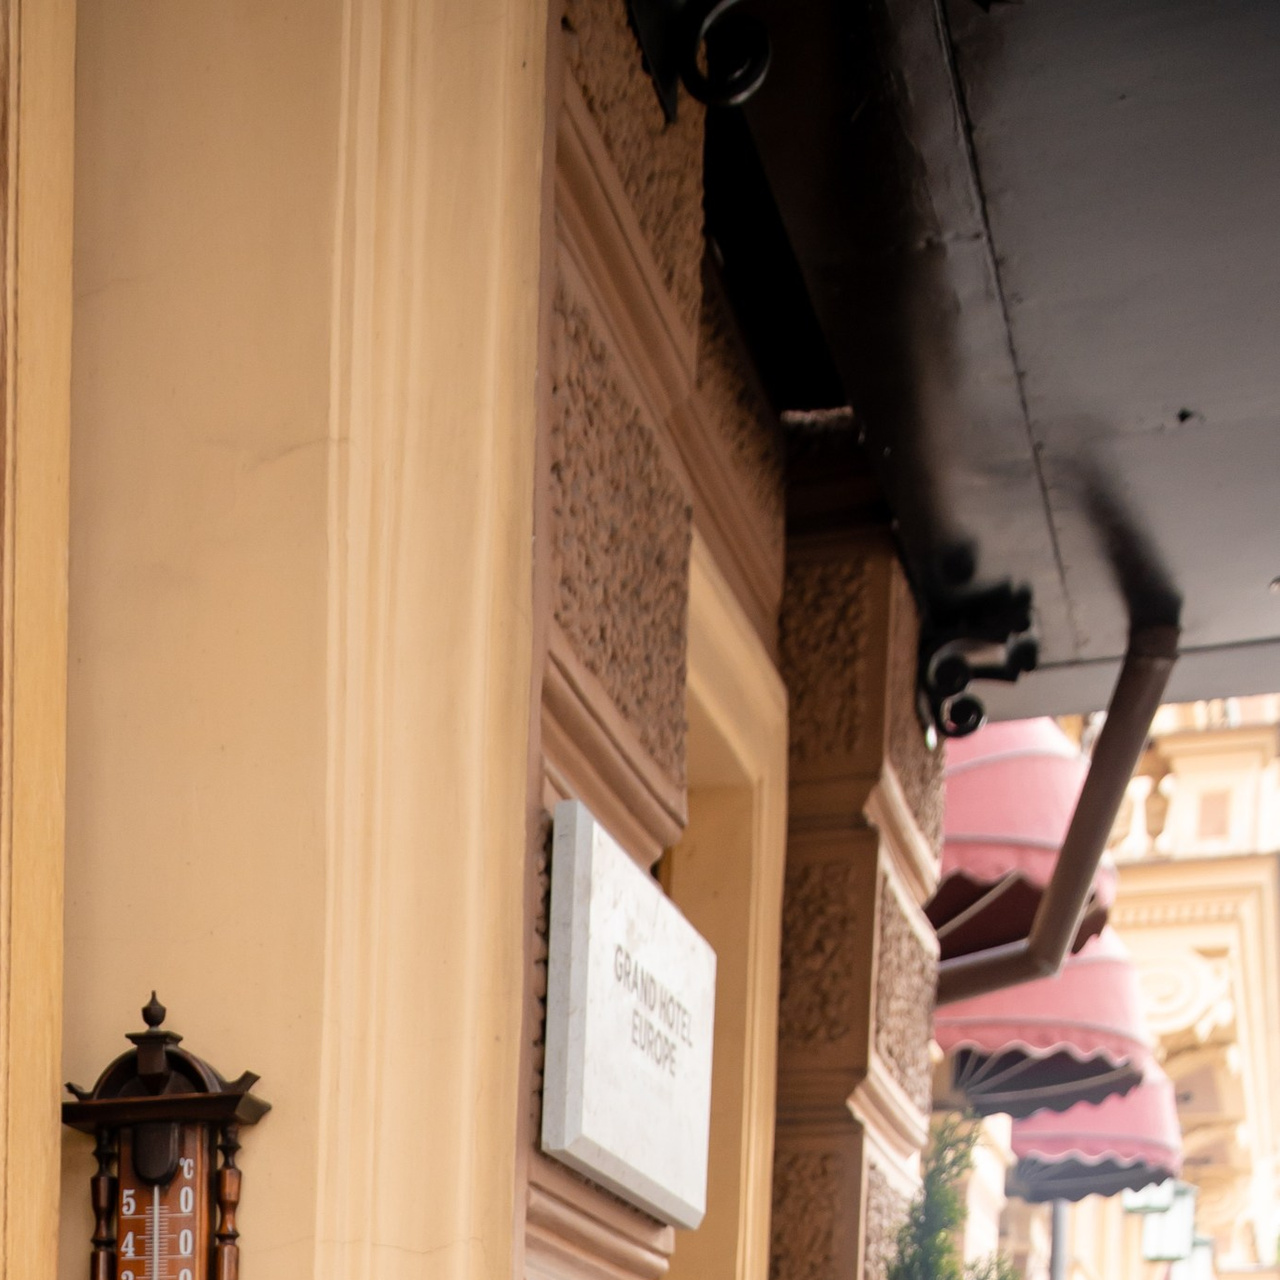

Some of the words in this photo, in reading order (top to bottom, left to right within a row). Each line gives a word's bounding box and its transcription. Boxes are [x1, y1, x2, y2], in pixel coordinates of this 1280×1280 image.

[614, 943, 657, 1012] GRAND
[658, 984, 694, 1049] HOTEL
[631, 1008, 677, 1078] EUROPE
[179, 1157, 194, 1180] °C
